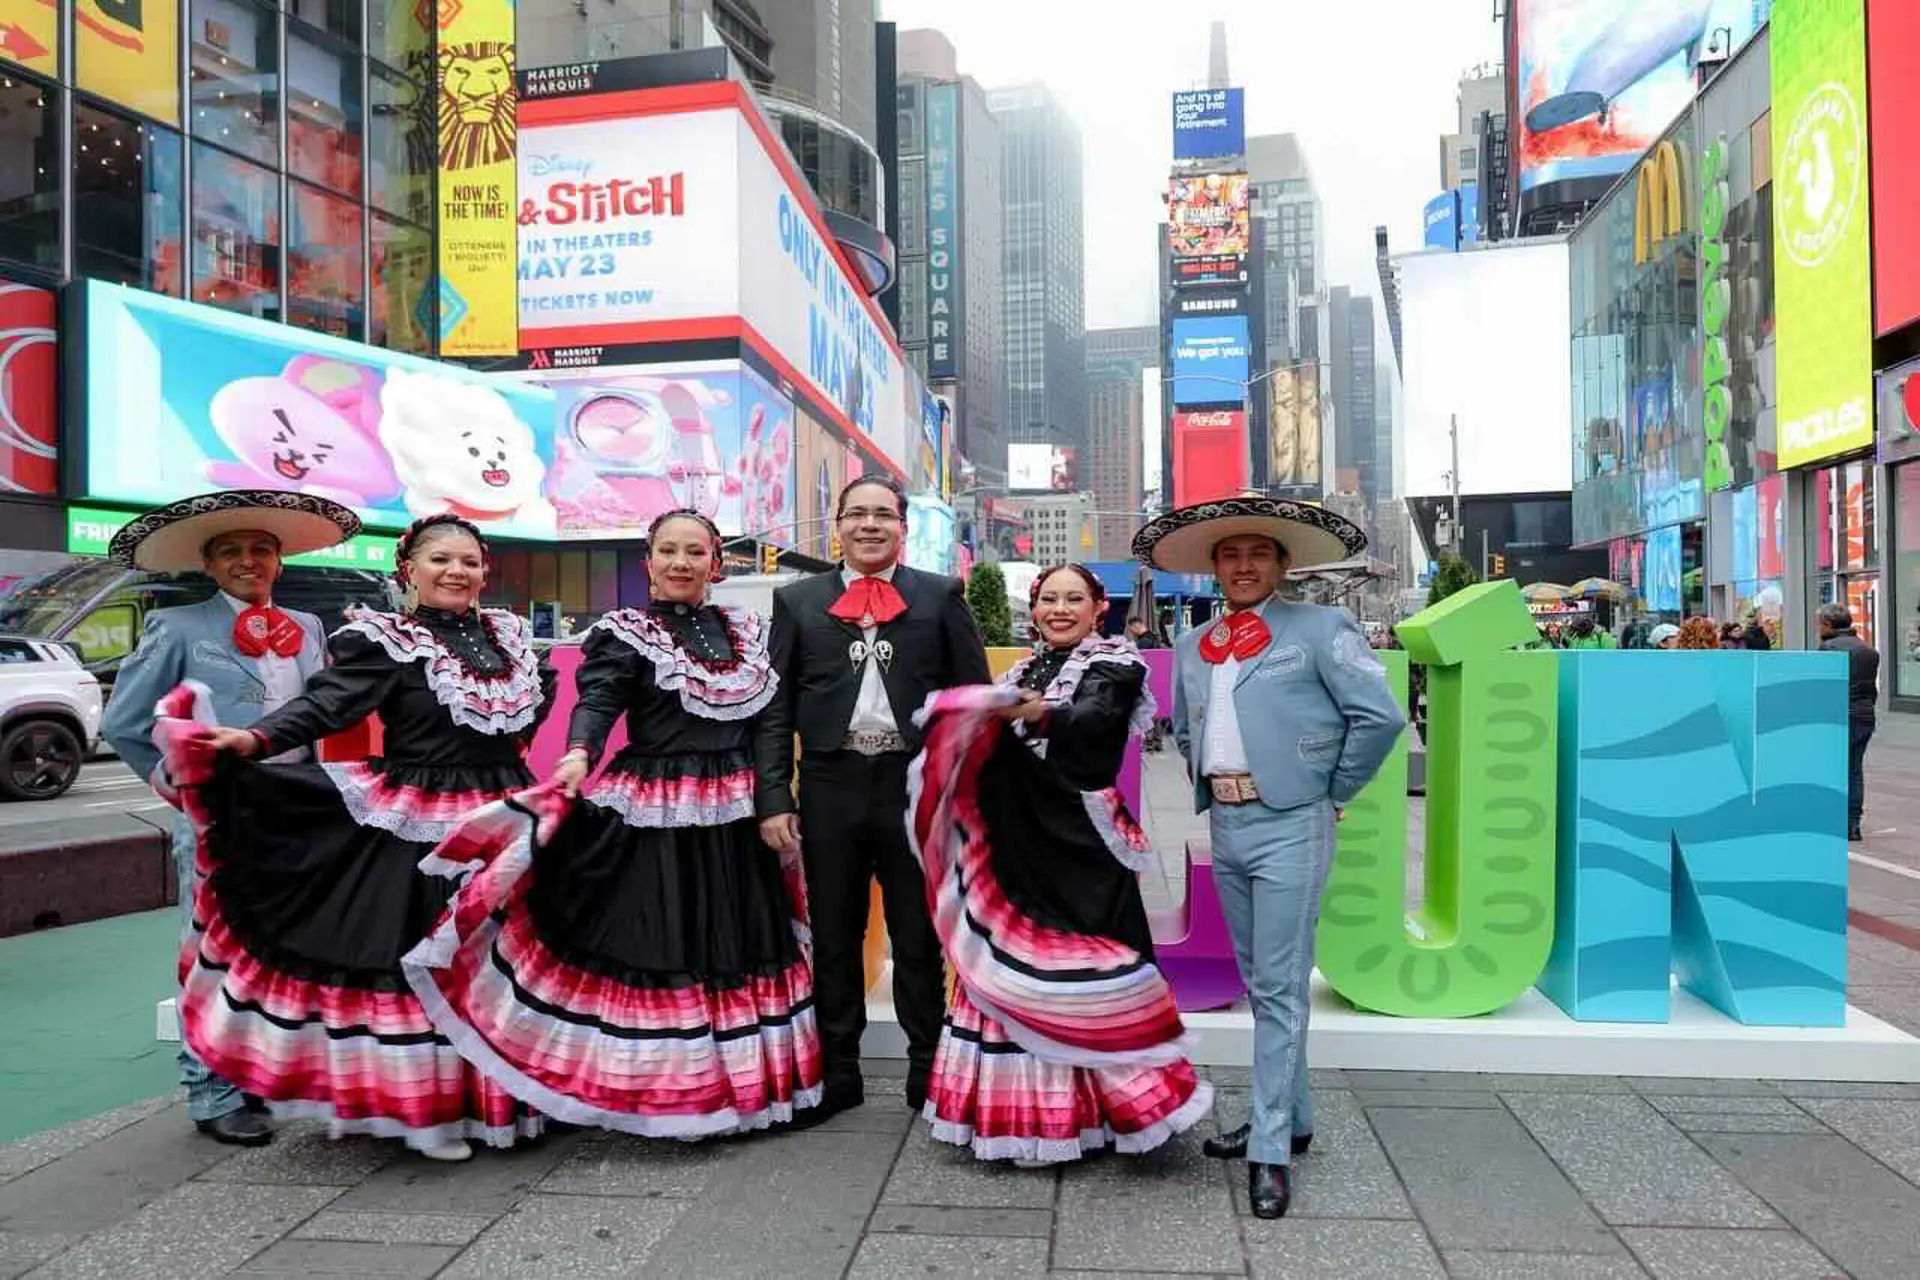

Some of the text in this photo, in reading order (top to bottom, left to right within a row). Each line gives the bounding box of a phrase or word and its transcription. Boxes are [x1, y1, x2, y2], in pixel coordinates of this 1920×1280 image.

[527, 64, 600, 81] MARRIOTT
[527, 78, 592, 95] MARQUIS
[527, 154, 594, 178] Disney
[928, 100, 948, 211] TIMES
[453, 184, 500, 201] NOW IS
[444, 202, 509, 219] THE TIME!
[518, 199, 542, 226] &
[527, 230, 653, 254] IN THEATERS
[779, 193, 821, 289] ONLY
[517, 252, 616, 281] MAY 23
[521, 289, 655, 311] TICKETS NOW
[930, 227, 948, 361] SQUARE
[554, 347, 603, 357] MARRIOTT
